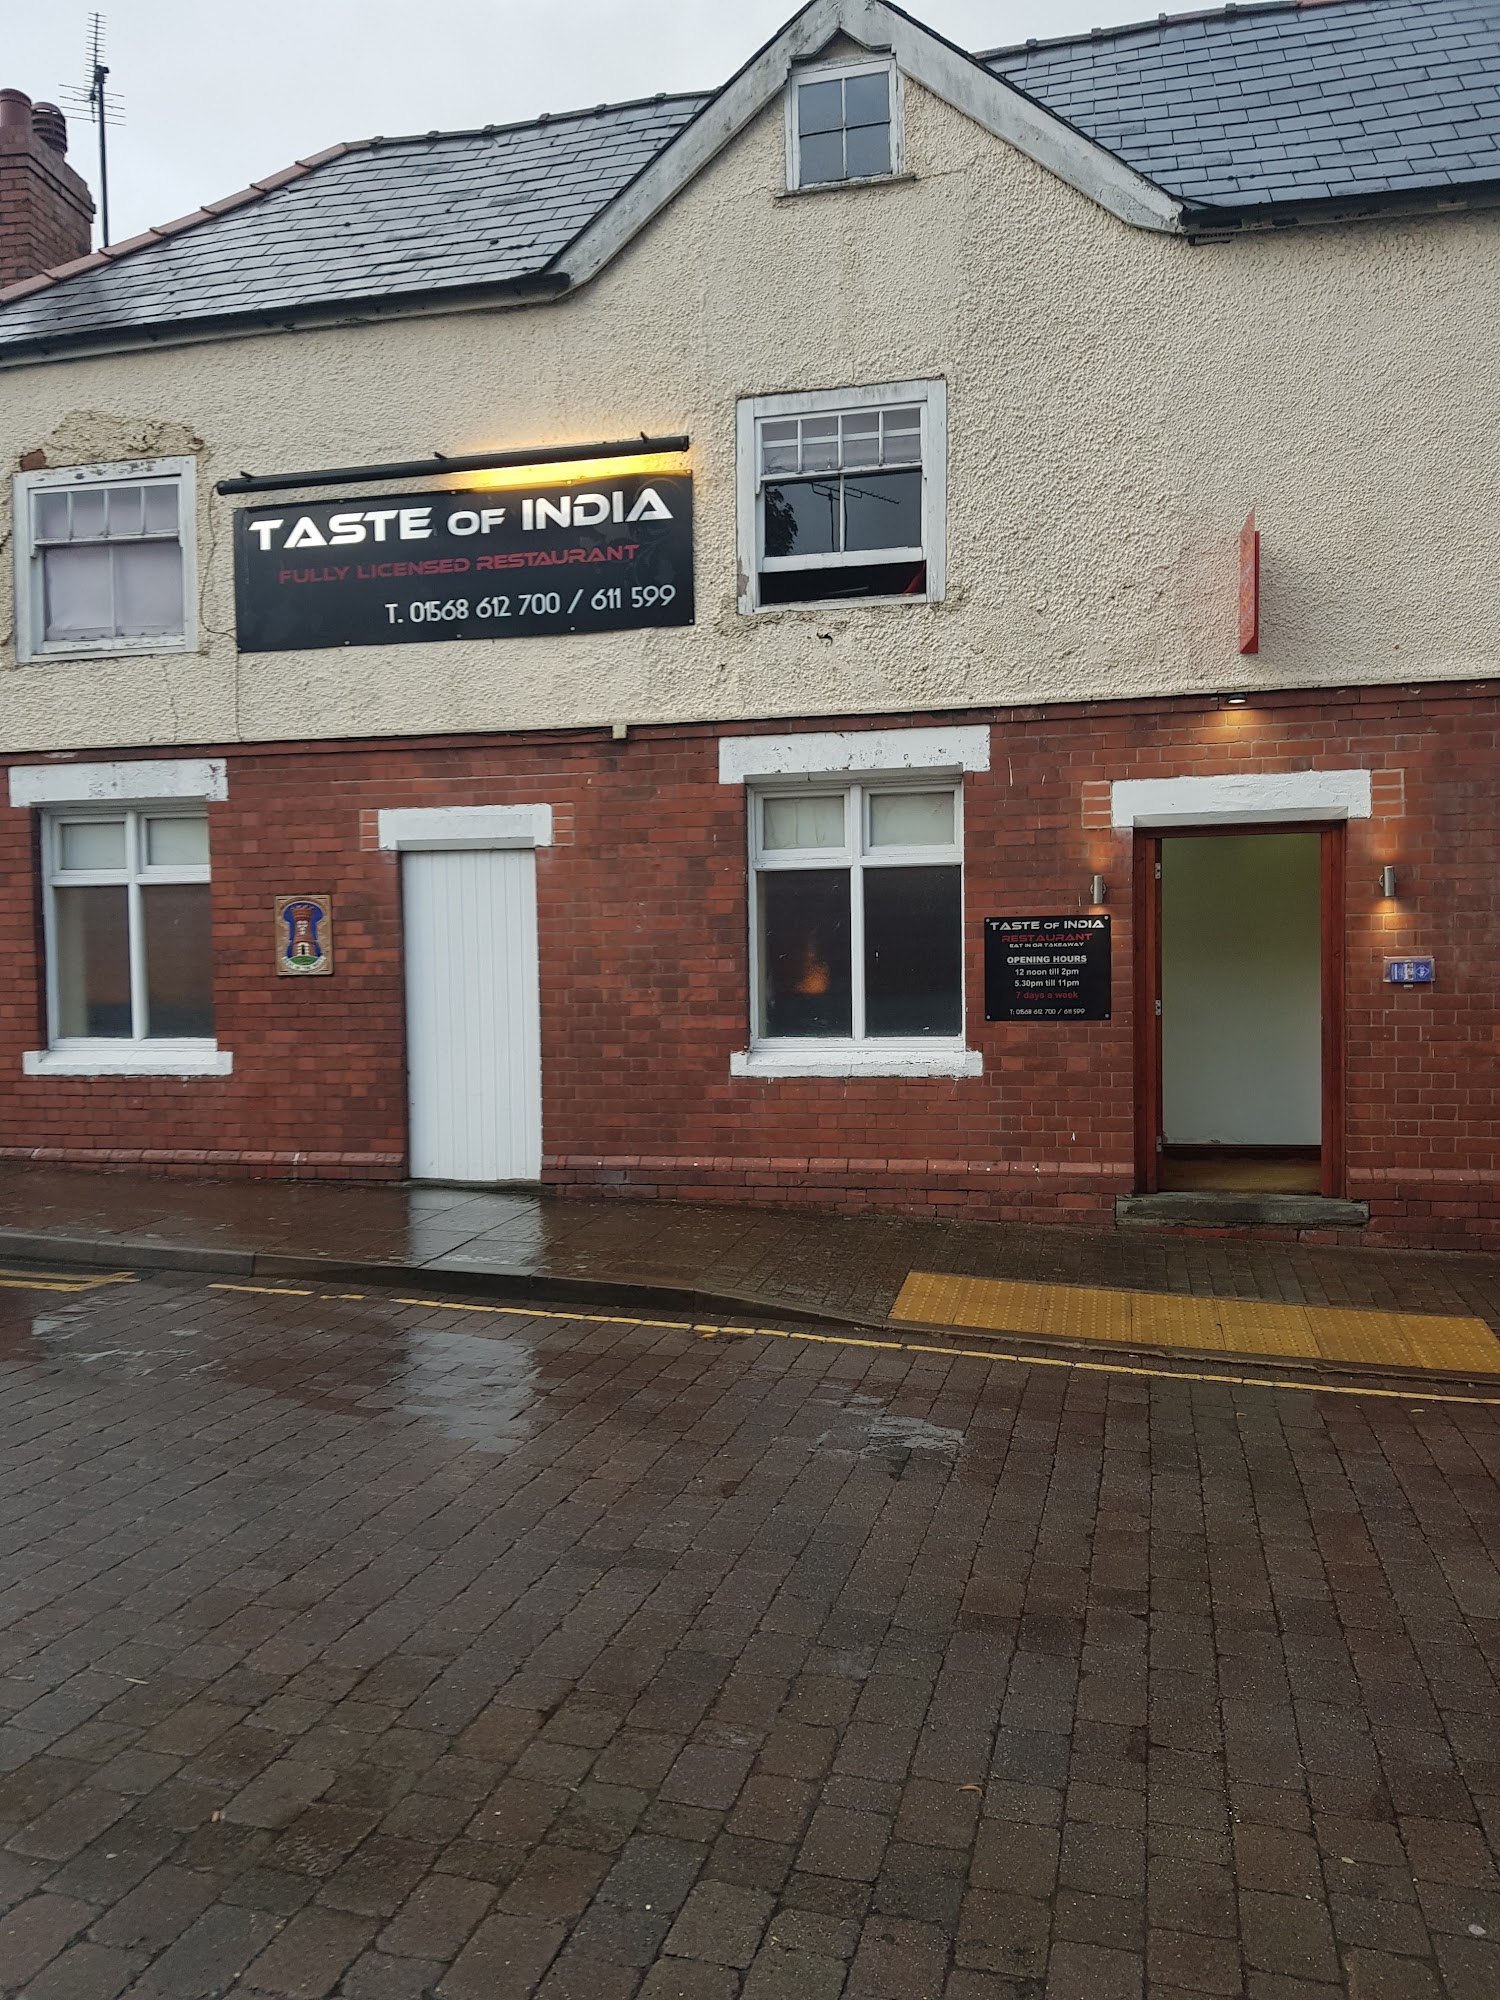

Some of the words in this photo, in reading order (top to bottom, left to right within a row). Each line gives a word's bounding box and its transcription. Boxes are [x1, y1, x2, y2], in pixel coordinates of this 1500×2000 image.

[248, 507, 434, 551] TASTE
[447, 507, 506, 536] OF
[521, 487, 674, 531] INDIA
[279, 566, 349, 584] FULLY
[357, 557, 470, 580] LICENSED
[476, 545, 639, 570] RESTAURANT
[385, 603, 404, 624] T.
[409, 599, 469, 623] 01568
[476, 596, 511, 618] 612
[519, 593, 560, 615] 700
[590, 587, 622, 611] 611
[631, 584, 676, 608] 599
[990, 921, 1040, 930] TASTE
[1064, 920, 1104, 929] INDIA
[1002, 933, 1092, 942] RESTAURANT
[1007, 956, 1050, 964] OPENING
[1053, 955, 1087, 963] HOURS
[1061, 968, 1079, 976] 2pm
[1015, 980, 1043, 988] 5.30pm
[1058, 979, 1079, 987] 11pm
[1024, 991, 1044, 1000] days
